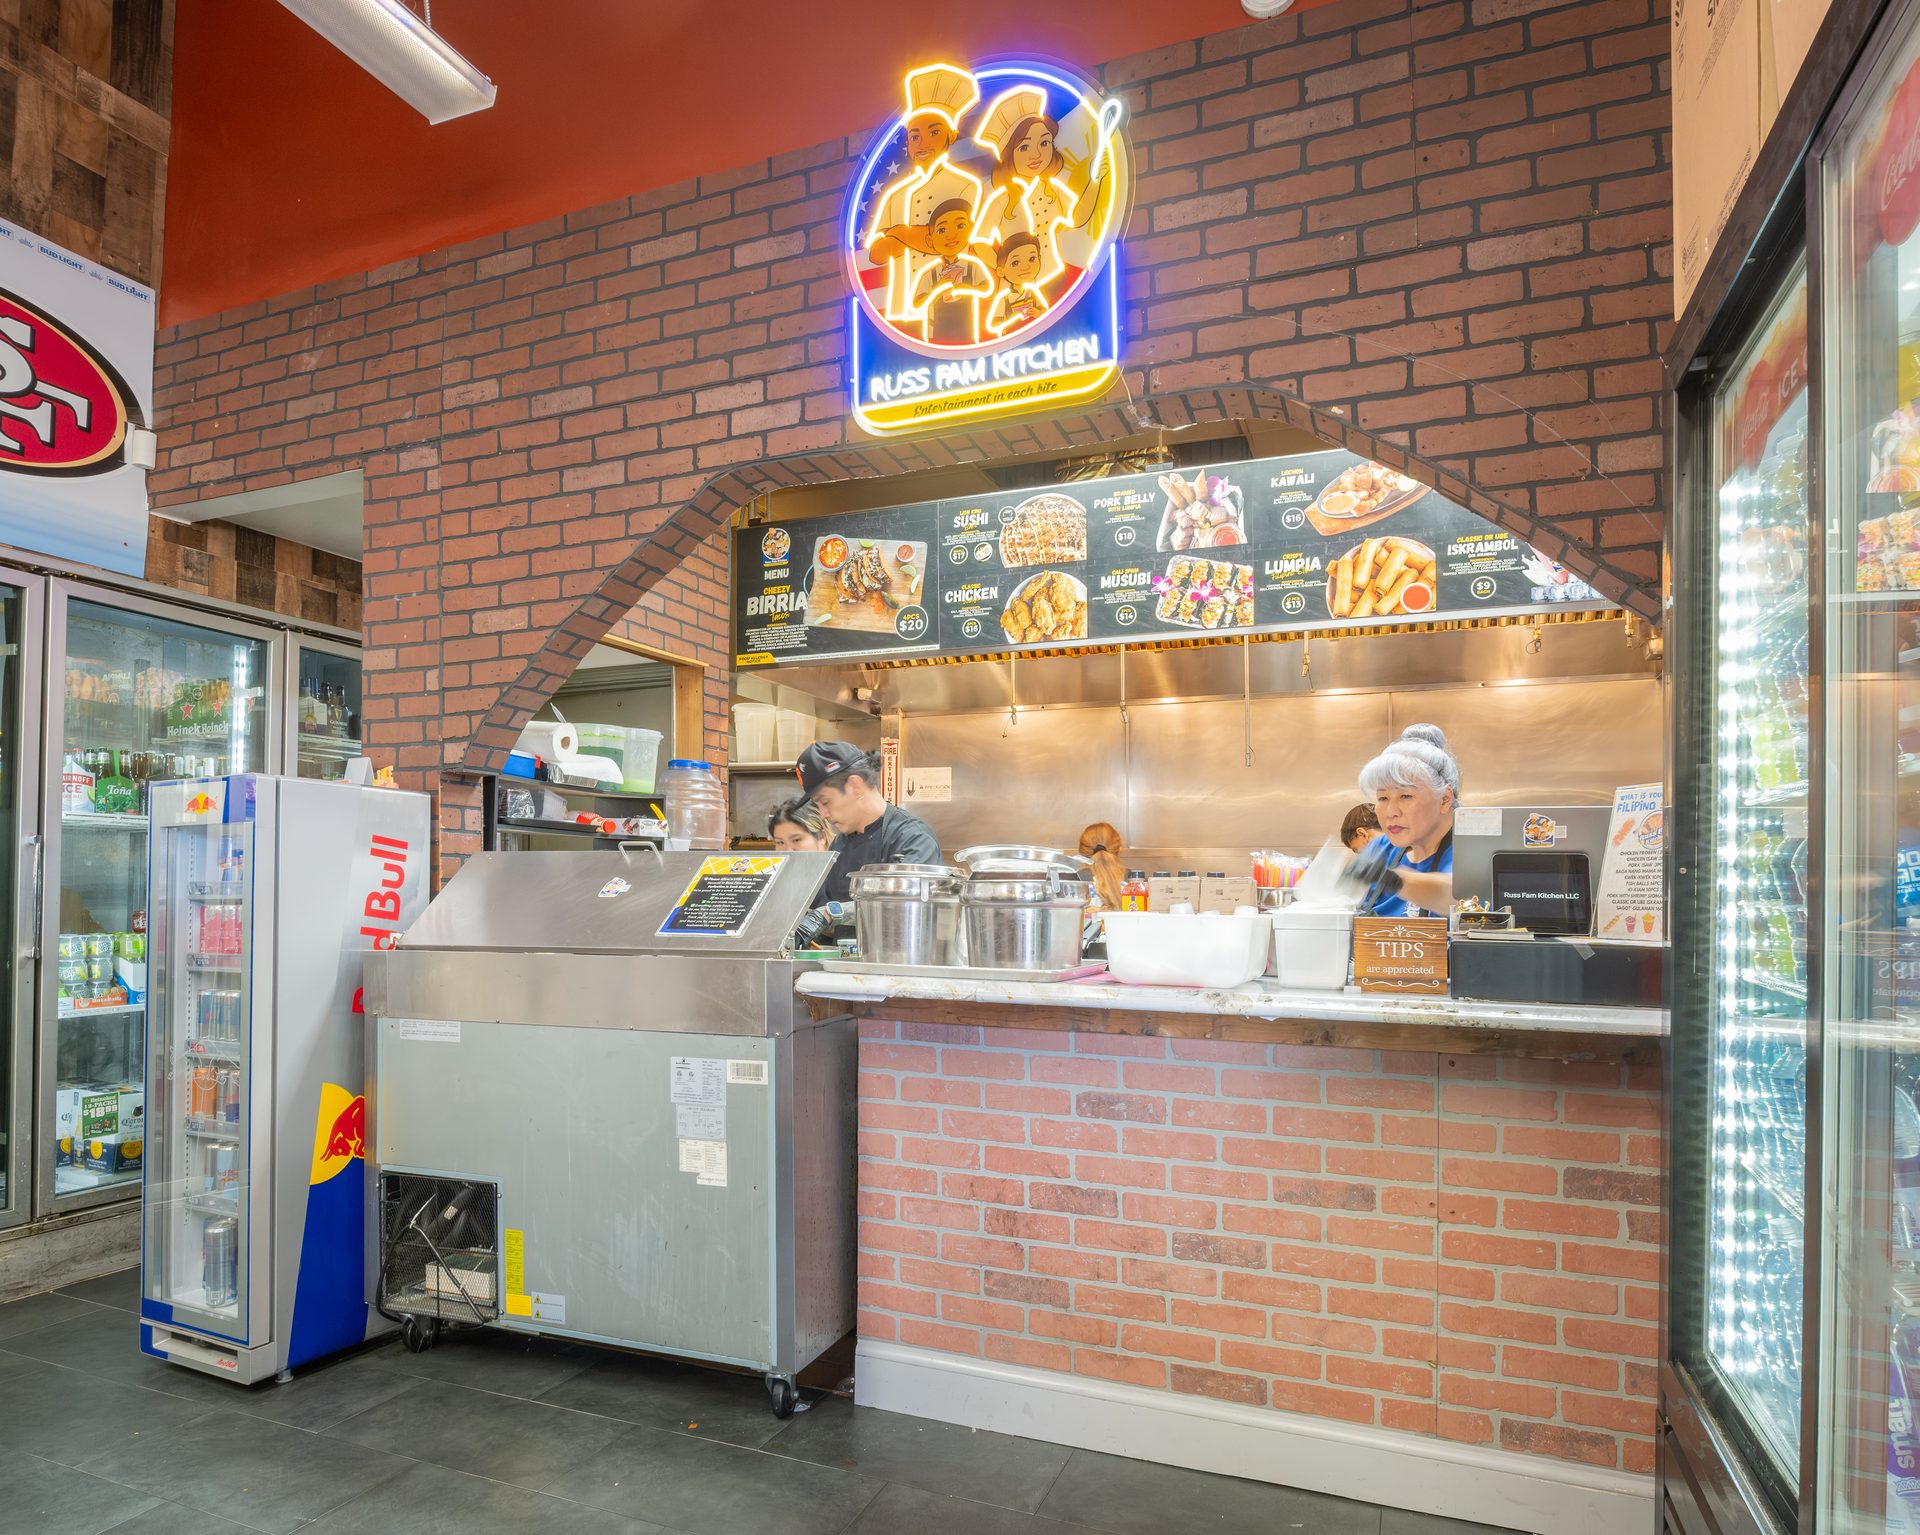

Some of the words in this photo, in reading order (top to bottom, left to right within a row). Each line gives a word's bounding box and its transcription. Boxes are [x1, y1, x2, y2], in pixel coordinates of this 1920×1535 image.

[40, 246, 58, 259] BUD
[59, 255, 83, 271] LIGHT
[109, 278, 125, 290] BUD
[126, 286, 148, 300] LIGHT
[870, 367, 930, 401] RUSS
[936, 356, 985, 390] FAM
[993, 334, 1098, 380] KITCHEN
[913, 394, 992, 417] Entertainment
[993, 391, 1005, 402] in
[1007, 385, 1034, 400] each
[1036, 381, 1058, 395] bite
[1271, 472, 1315, 488] KAWALI
[1094, 496, 1121, 509] PORK
[1124, 492, 1156, 505] BELLY
[953, 512, 989, 528] SUSHI
[1285, 514, 1301, 523] $16
[1118, 532, 1133, 541] $18
[1456, 535, 1483, 544] CLASSIC
[1447, 538, 1519, 556] ISKRAMBOL
[952, 551, 966, 560] $17
[1265, 556, 1322, 575] LUMPIA
[764, 568, 790, 580] MENU
[1100, 571, 1151, 589] MUSUBI
[763, 584, 791, 595] CHEEZY
[1476, 581, 1490, 590] $9
[945, 586, 998, 604] CHICKEN
[746, 591, 809, 616] BIRRIA
[1285, 600, 1302, 609] $13
[1119, 612, 1134, 621] $14
[899, 618, 924, 633] $20
[965, 624, 979, 633] $16
[883, 747, 897, 755] FIRE
[107, 784, 132, 795] Toña
[1620, 793, 1638, 801] WHAT
[364, 834, 409, 921] Bull
[1538, 891, 1564, 899] Kitchen
[1376, 941, 1424, 959] TIPS
[1382, 965, 1434, 975] appreciated
[90, 1095, 116, 1103] Heineken
[1888, 1398, 1915, 1469] smart
